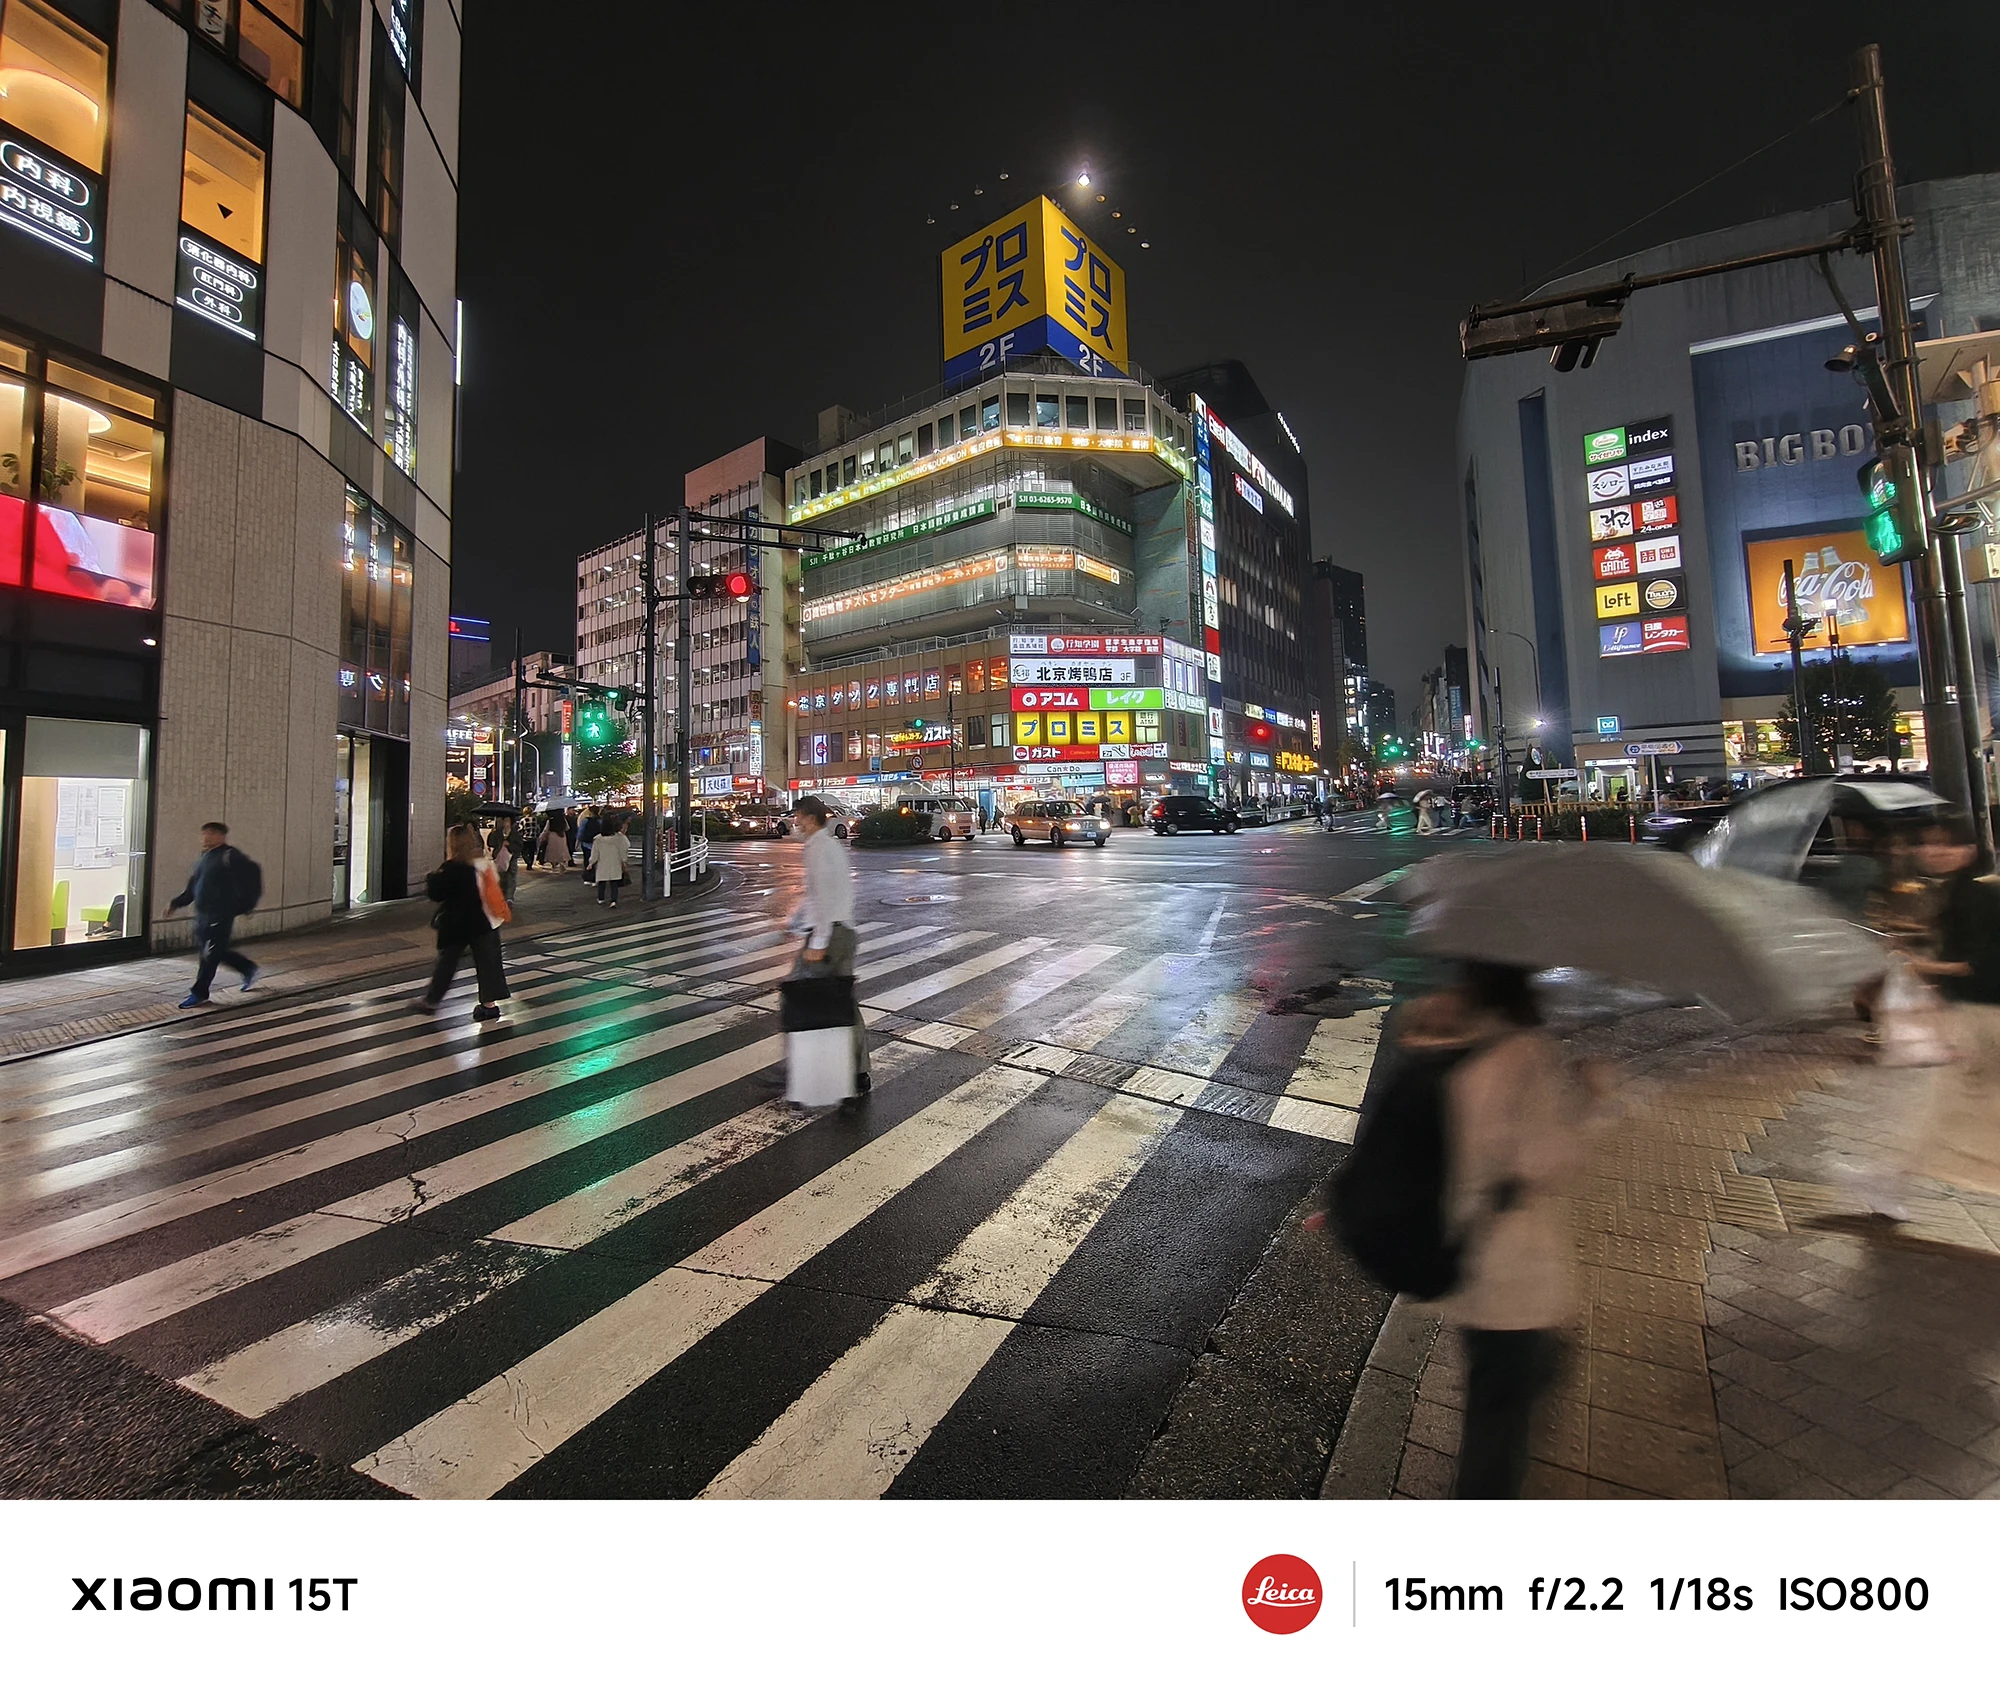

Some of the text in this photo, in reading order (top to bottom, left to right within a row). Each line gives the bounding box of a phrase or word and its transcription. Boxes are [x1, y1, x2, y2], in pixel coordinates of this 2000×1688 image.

[14, 153, 74, 196] 内科
[1, 183, 82, 236] 内視鏡
[960, 221, 1028, 291] プロ
[1061, 225, 1112, 305] プロ
[200, 271, 236, 297] 肛門科
[203, 295, 231, 316] 外科
[963, 269, 1030, 334] ミス
[1064, 274, 1114, 351] ミス
[979, 332, 1015, 371] 2F
[1079, 344, 1103, 377] 2F
[1629, 429, 1668, 445] index
[1590, 448, 1623, 461] サイゼリヤ
[1735, 433, 1805, 473] BIG
[1592, 479, 1626, 491] スシロー
[1029, 495, 1073, 505] 03-6265-9570
[1600, 558, 1630, 573] GAME
[1644, 622, 1662, 631] 日産
[1645, 629, 1684, 640] レンタカー
[1066, 639, 1099, 649] 行知学園
[1120, 672, 1131, 681] 3F
[1040, 692, 1079, 706] アコム
[1106, 690, 1144, 704] レイク
[923, 725, 951, 742] ガスト
[1022, 719, 1124, 737] プロミス
[1032, 746, 1061, 758] ガスト
